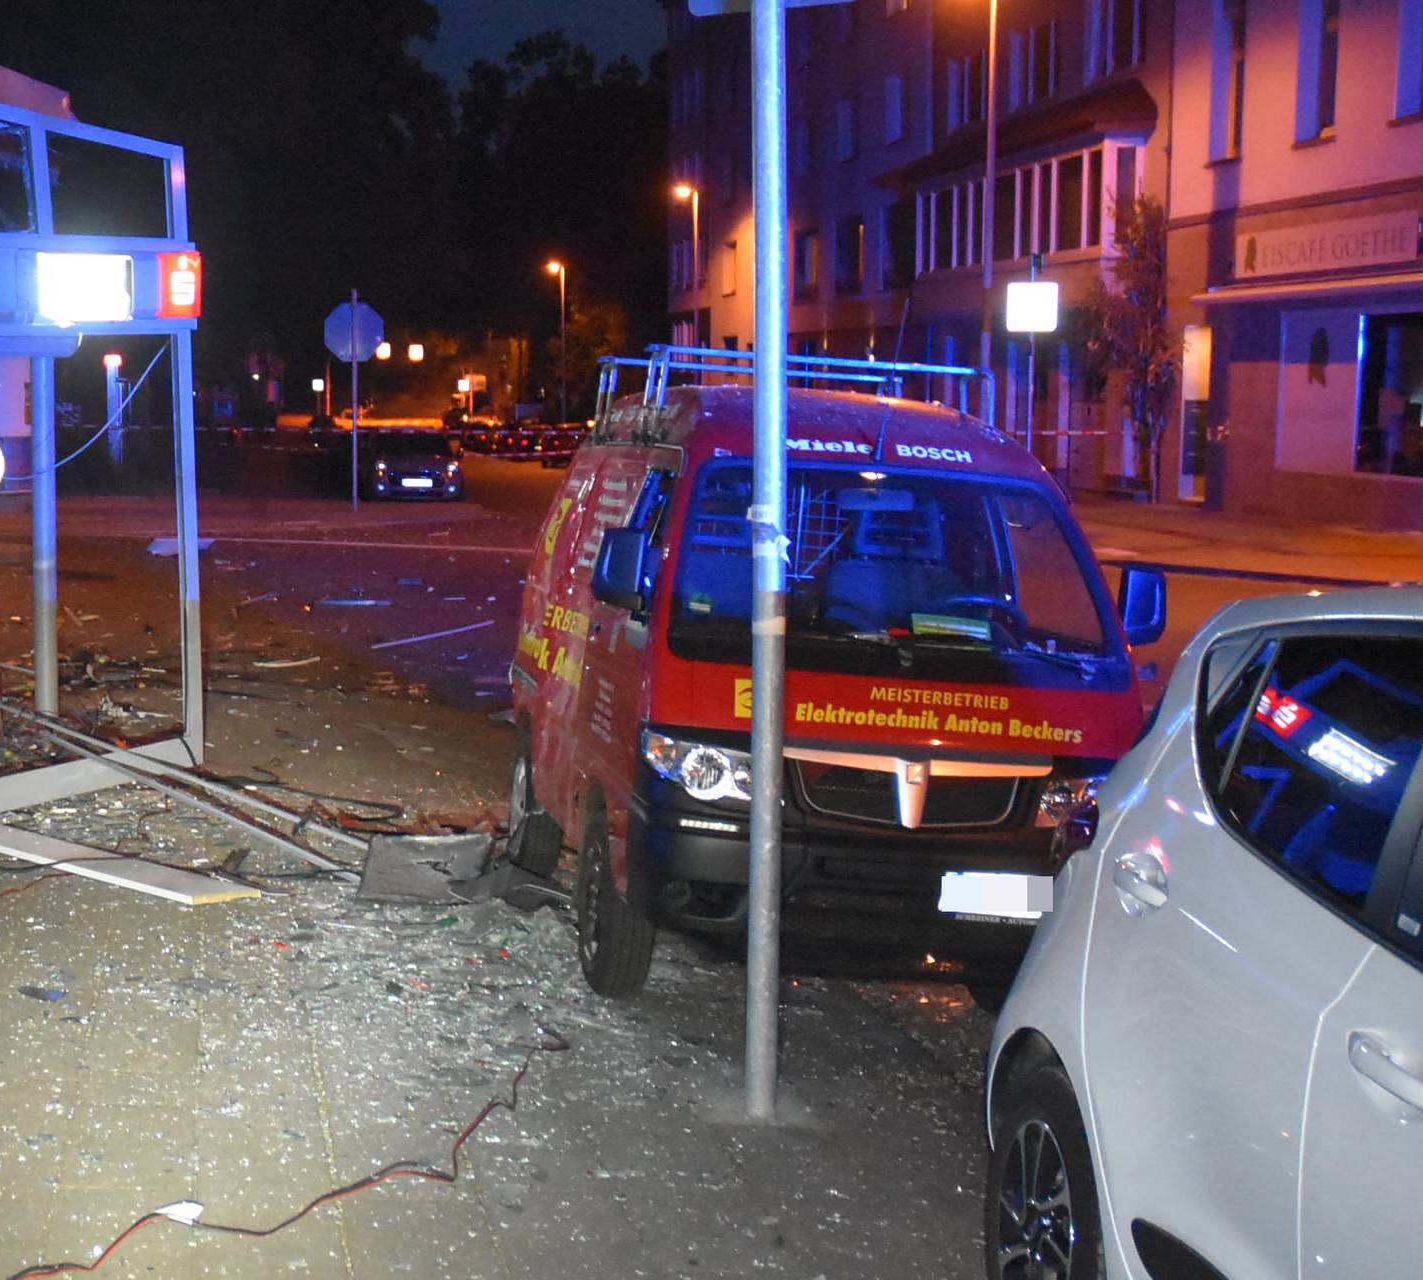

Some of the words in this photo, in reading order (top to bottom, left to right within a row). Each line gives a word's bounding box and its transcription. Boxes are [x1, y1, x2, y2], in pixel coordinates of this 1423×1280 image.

[786, 439, 873, 454] Miele
[896, 444, 972, 464] BOSCH
[870, 686, 1009, 710] MEISTERBETRIEB
[795, 702, 939, 730] Elektrotechnik
[944, 713, 1003, 735] Anton
[1008, 719, 1083, 743] Beckers
